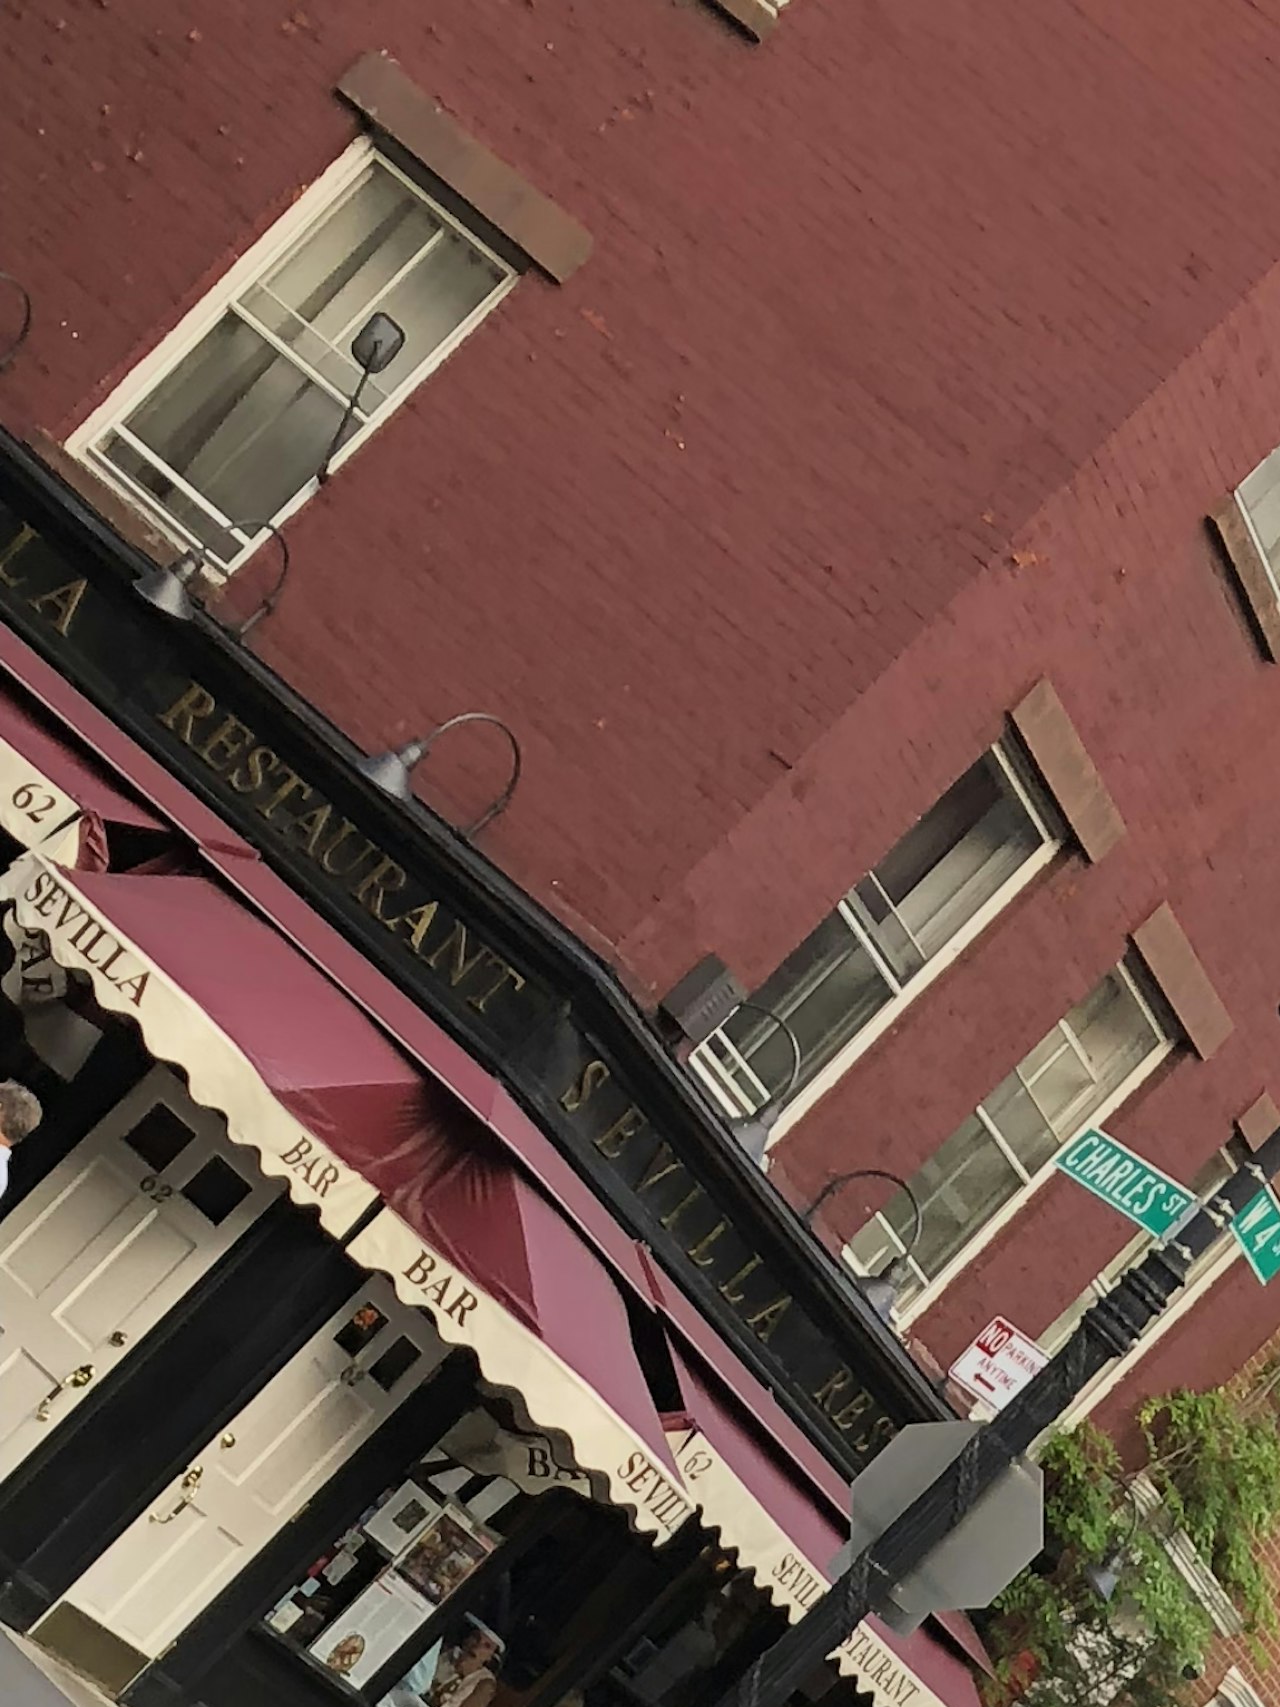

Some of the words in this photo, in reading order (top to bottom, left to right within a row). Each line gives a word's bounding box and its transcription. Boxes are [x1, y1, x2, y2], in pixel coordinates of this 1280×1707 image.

[11, 782, 58, 825] 62
[22, 869, 155, 1008] SEVILLA
[155, 681, 526, 1014] RESTAURANT
[559, 1059, 795, 1345] SEVILLA
[278, 1136, 343, 1200] BAR
[1063, 1134, 1168, 1217] CHARLES
[1160, 1191, 1187, 1218] ST
[1236, 1194, 1269, 1235] W
[1250, 1221, 1276, 1254] 4
[400, 1248, 480, 1329] BAR
[979, 1322, 1010, 1354] NO
[976, 1357, 1020, 1393] ANYTIME
[683, 1450, 713, 1481] 62
